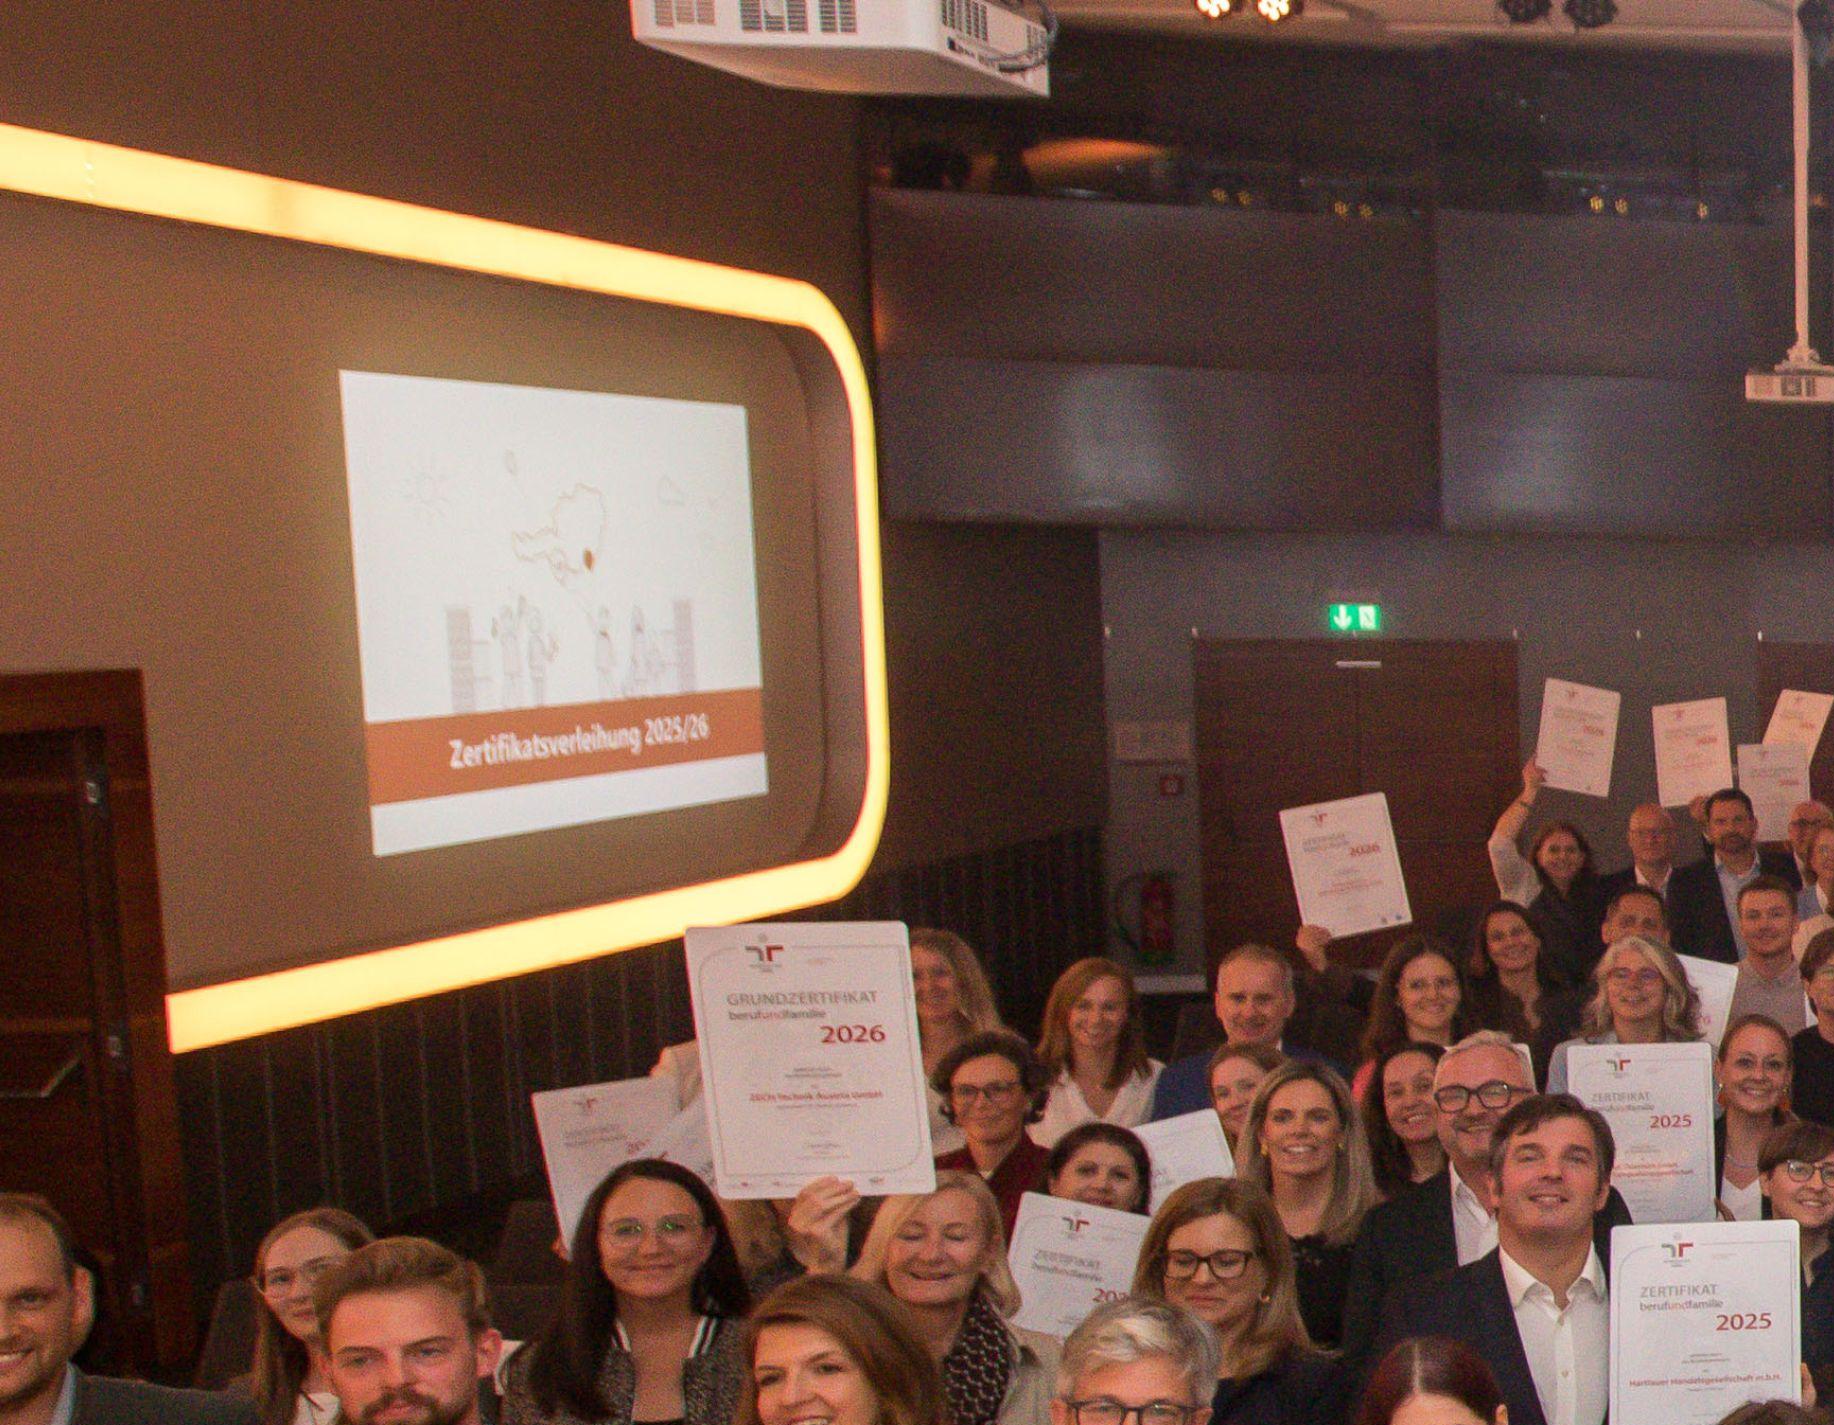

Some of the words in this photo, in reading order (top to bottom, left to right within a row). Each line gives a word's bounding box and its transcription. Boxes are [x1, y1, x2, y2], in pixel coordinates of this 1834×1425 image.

[449, 722, 642, 770] Zertifikatsverleihung
[644, 713, 710, 745] 2025/26
[727, 991, 877, 1006] GRUNDZERTIFIKAT
[820, 1024, 886, 1044] 2026
[1650, 1115, 1692, 1128] 2025
[1093, 1287, 1130, 1303] 202
[1640, 1284, 1718, 1298] ZERTIFIKAT
[1640, 1299, 1723, 1312] berufundfamilie
[1716, 1312, 1772, 1331] 2025
